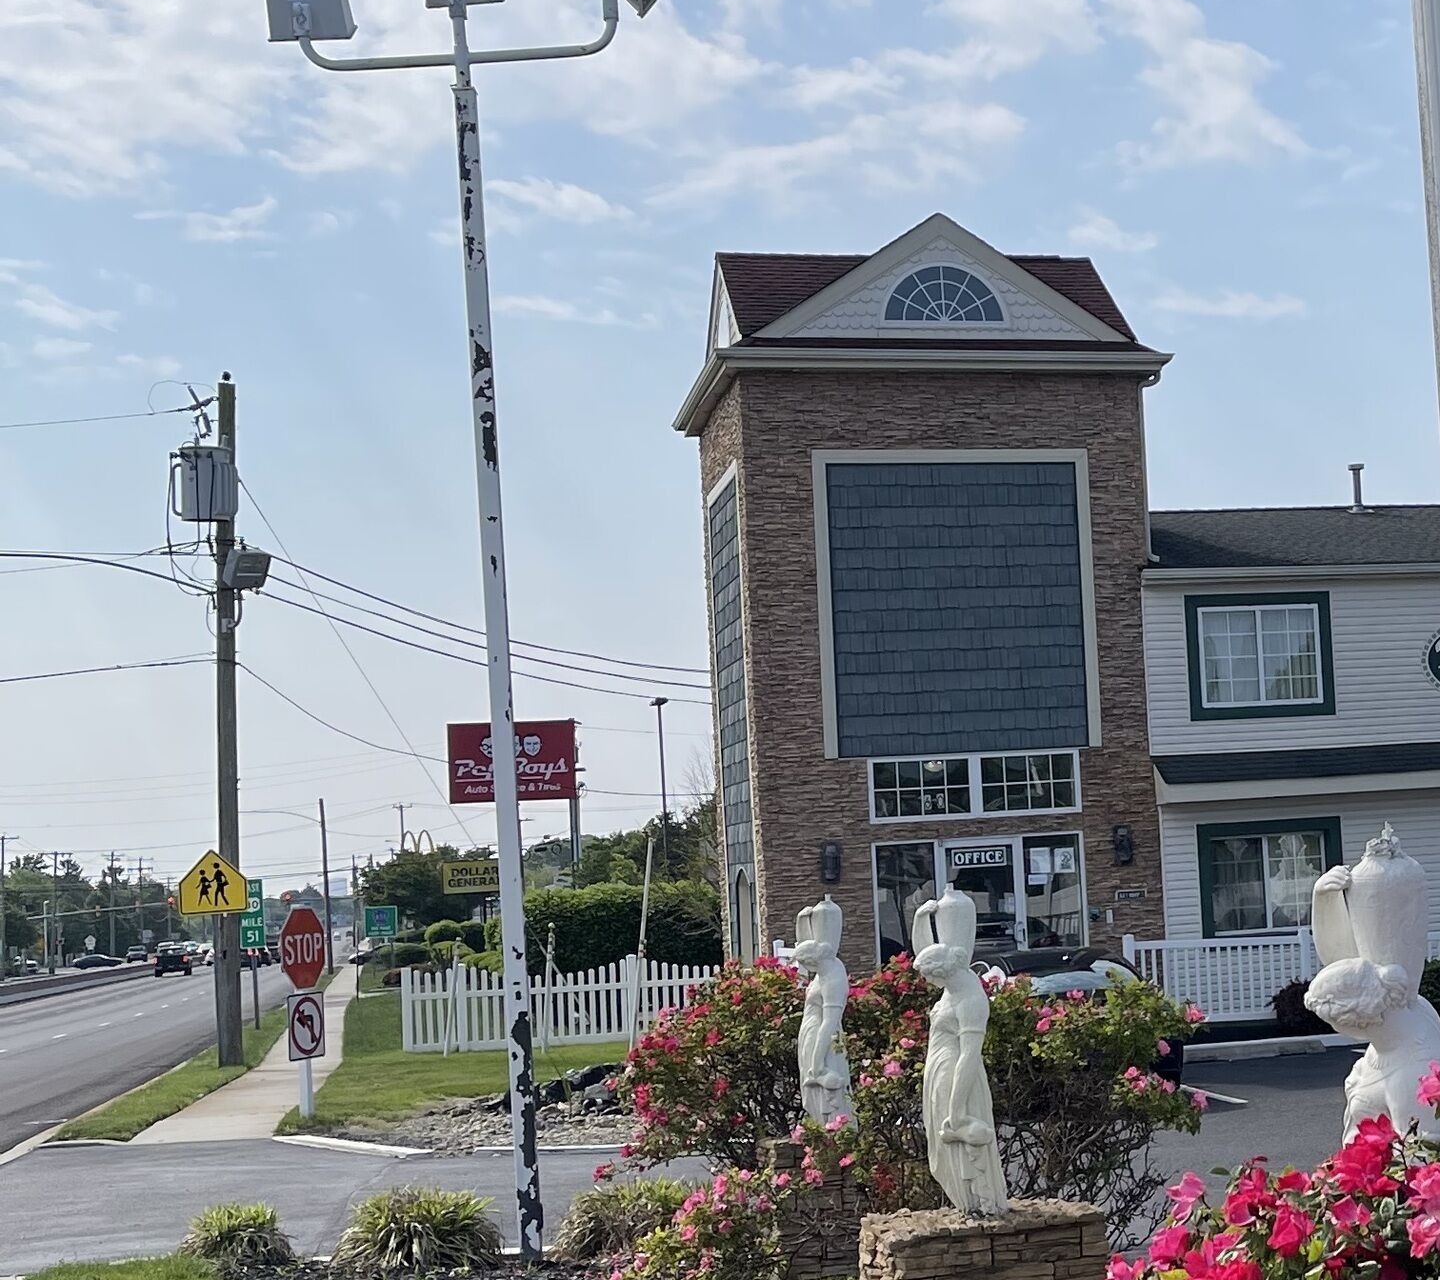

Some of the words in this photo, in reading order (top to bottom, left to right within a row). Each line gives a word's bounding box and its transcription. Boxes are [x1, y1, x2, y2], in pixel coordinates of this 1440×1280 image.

[464, 785, 488, 794] Auto
[954, 850, 1004, 864] OFFICE
[451, 866, 498, 877] DOLLAR
[241, 917, 263, 927] MILE
[246, 930, 259, 942] 51
[284, 932, 322, 966] STOP
